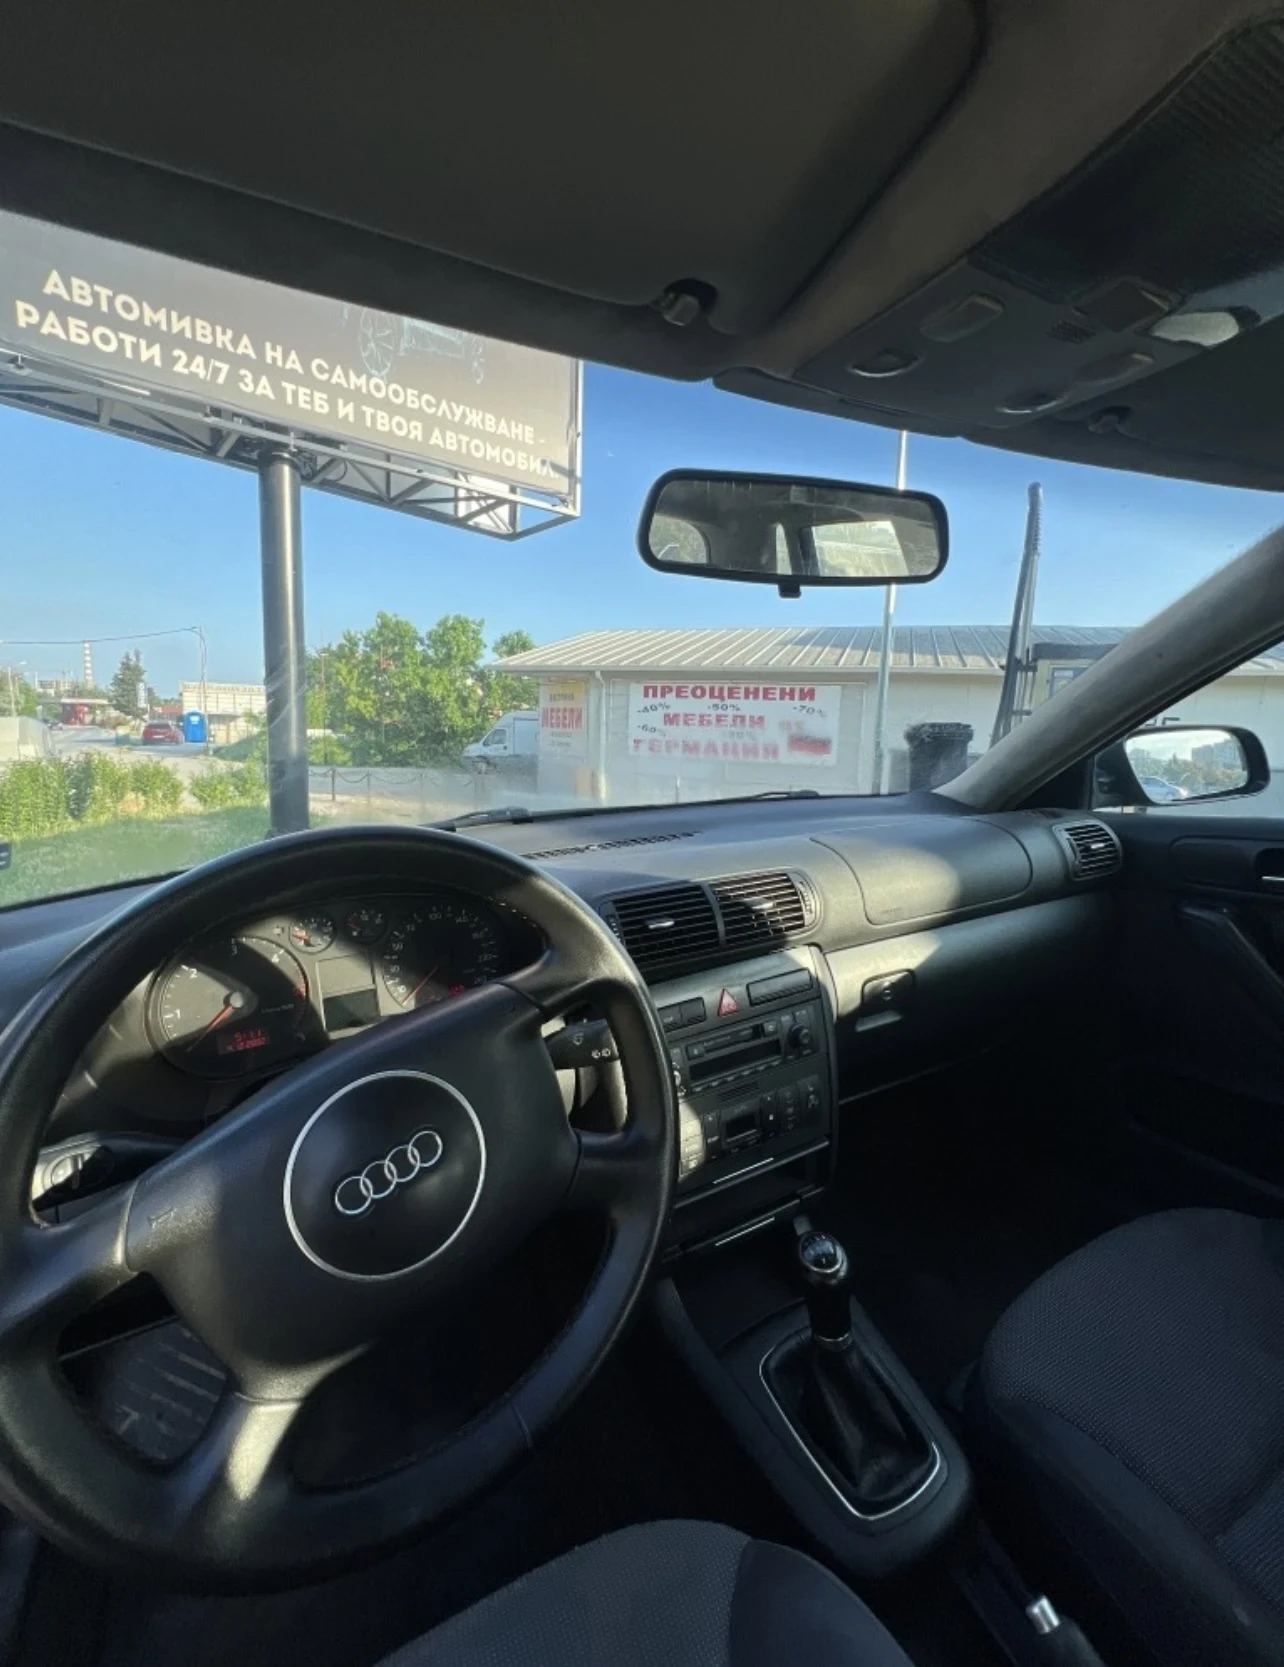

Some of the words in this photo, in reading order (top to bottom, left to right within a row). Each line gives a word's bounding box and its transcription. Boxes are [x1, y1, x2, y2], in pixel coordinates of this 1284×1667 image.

[43, 268, 257, 360] АВТОМИВКА
[265, 341, 304, 374] НА
[311, 358, 534, 445] САМООБСЛУЖВАНЕ
[15, 299, 162, 367] РАБОТИ
[172, 349, 230, 385] 24/7
[237, 368, 276, 400] ЗА
[281, 380, 330, 414] ТЕБ
[337, 398, 354, 423] И
[361, 405, 423, 442] ТВОЯ
[643, 685, 816, 702] ПРЕОЦЕНЕНИ
[708, 703, 741, 712] -50%
[541, 707, 583, 729] МЕБЕЛИ
[663, 712, 765, 729] МЕБЕЛИ
[189, 967, 198, 978] 2
